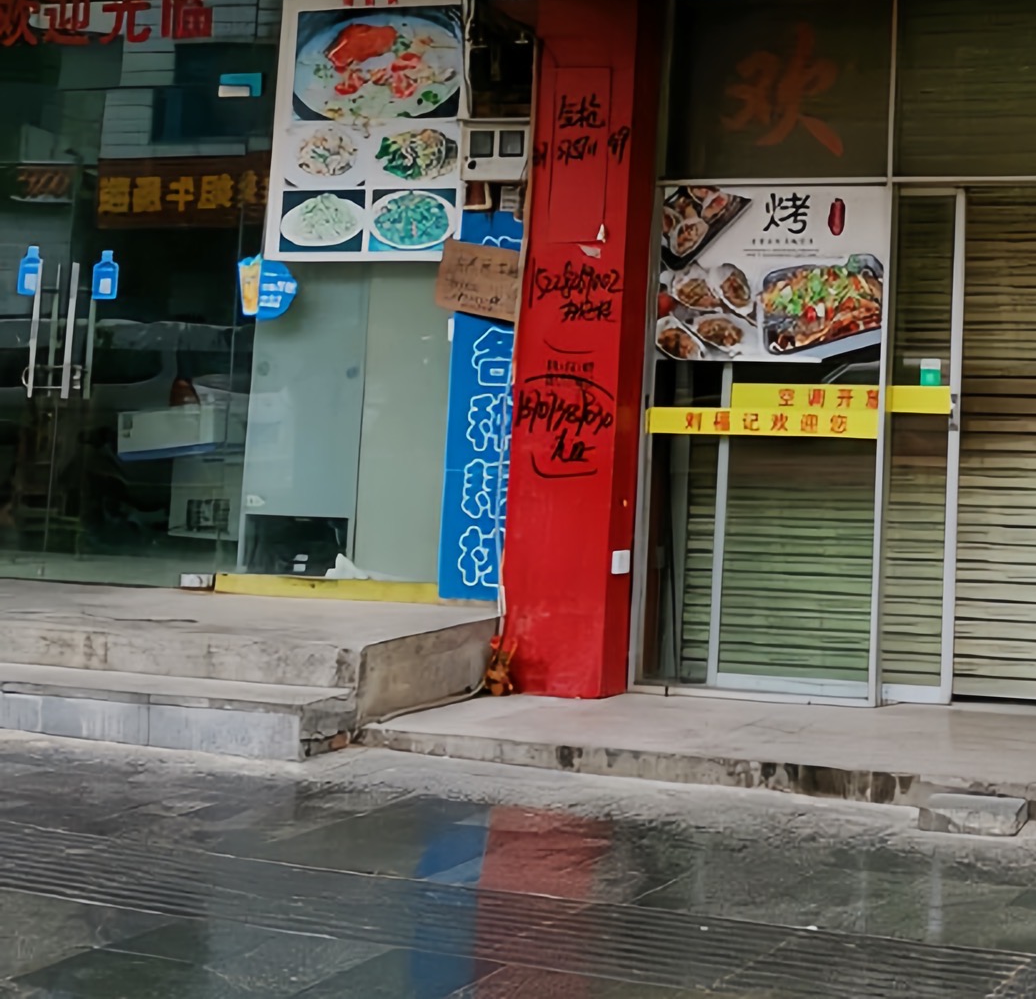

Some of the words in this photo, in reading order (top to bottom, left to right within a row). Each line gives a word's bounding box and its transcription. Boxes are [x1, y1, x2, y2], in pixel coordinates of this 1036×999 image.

[763, 192, 811, 234] 烤
[685, 411, 848, 433] 刘福记欢迎您
